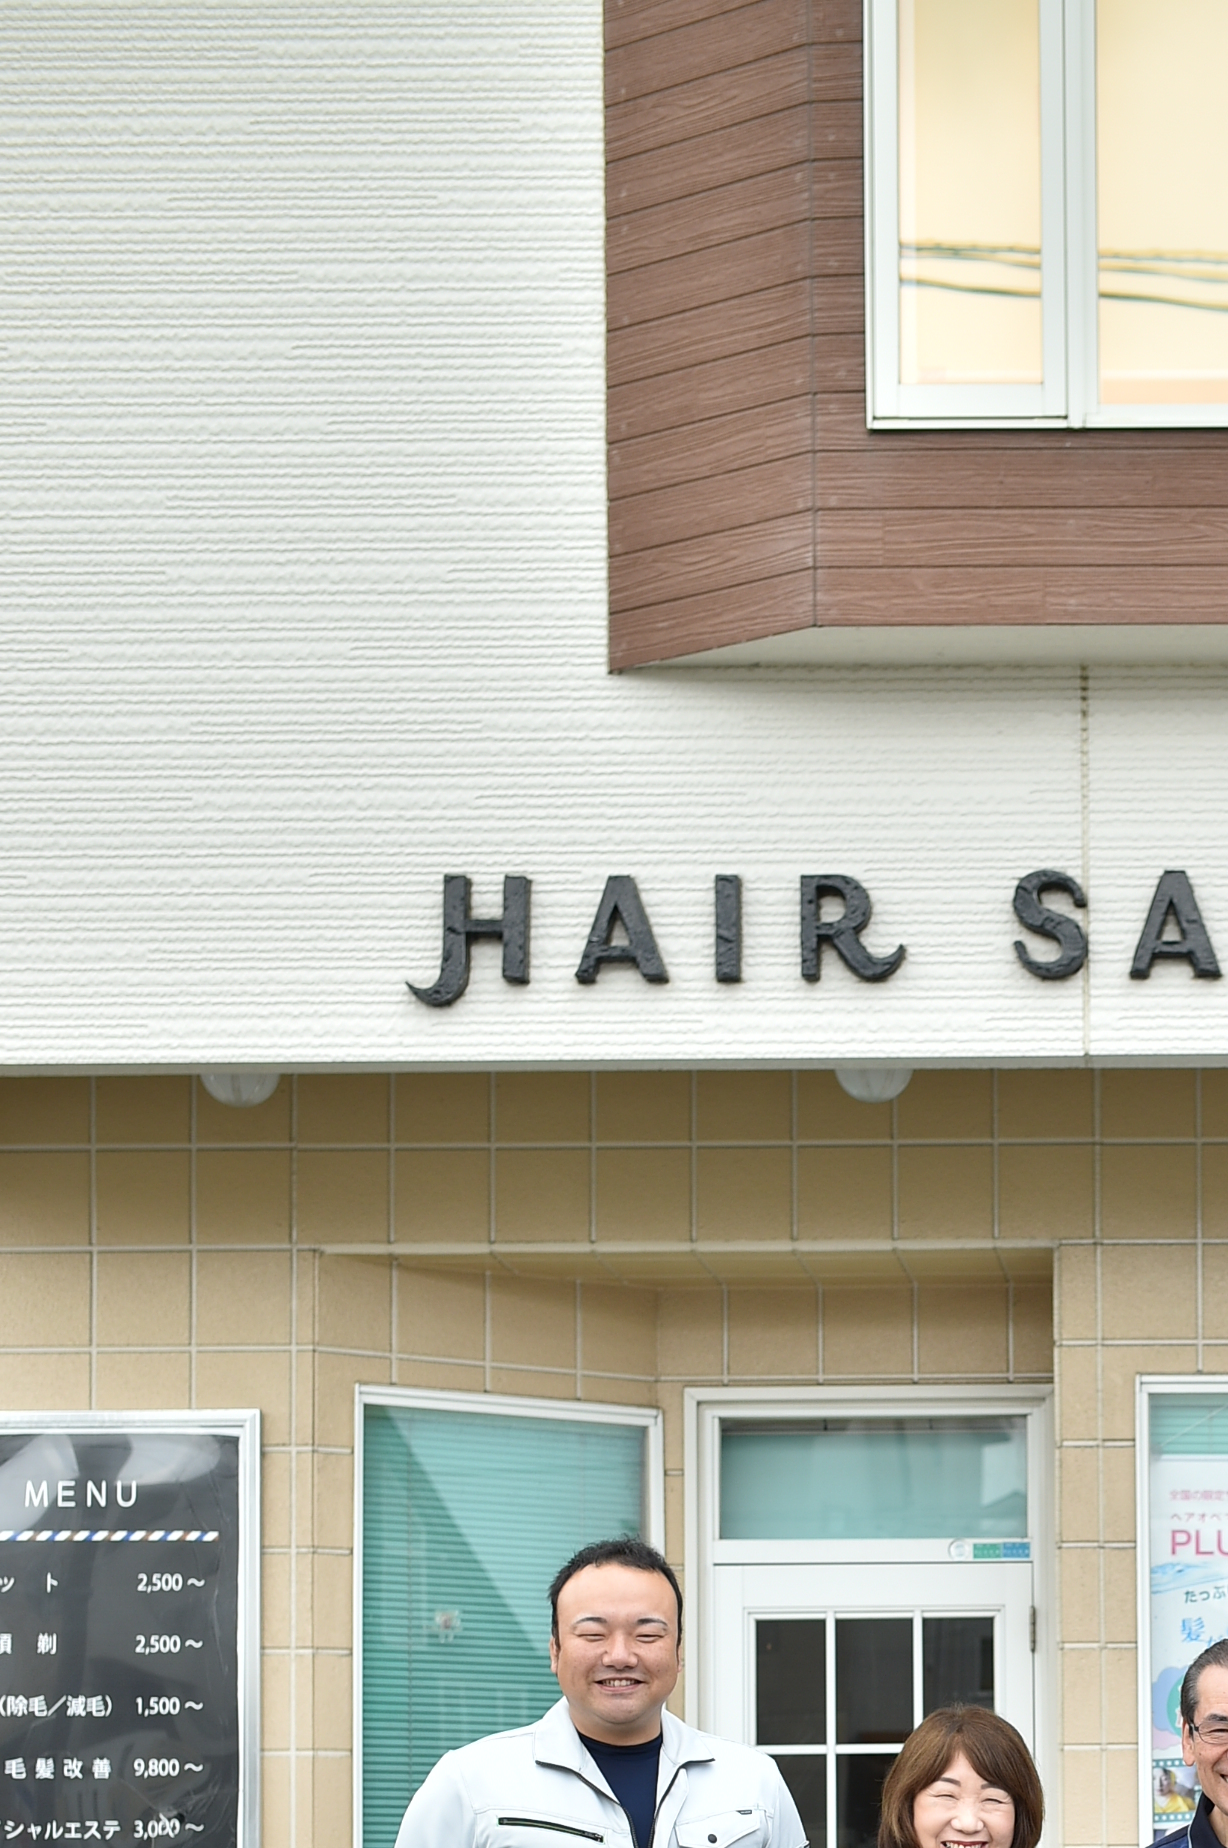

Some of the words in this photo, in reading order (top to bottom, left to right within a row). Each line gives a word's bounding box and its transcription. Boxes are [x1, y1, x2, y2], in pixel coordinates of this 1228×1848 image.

[405, 872, 907, 1008] HAIR
[24, 1479, 139, 1508] MENU
[0, 1819, 121, 1841] シャルエステ
